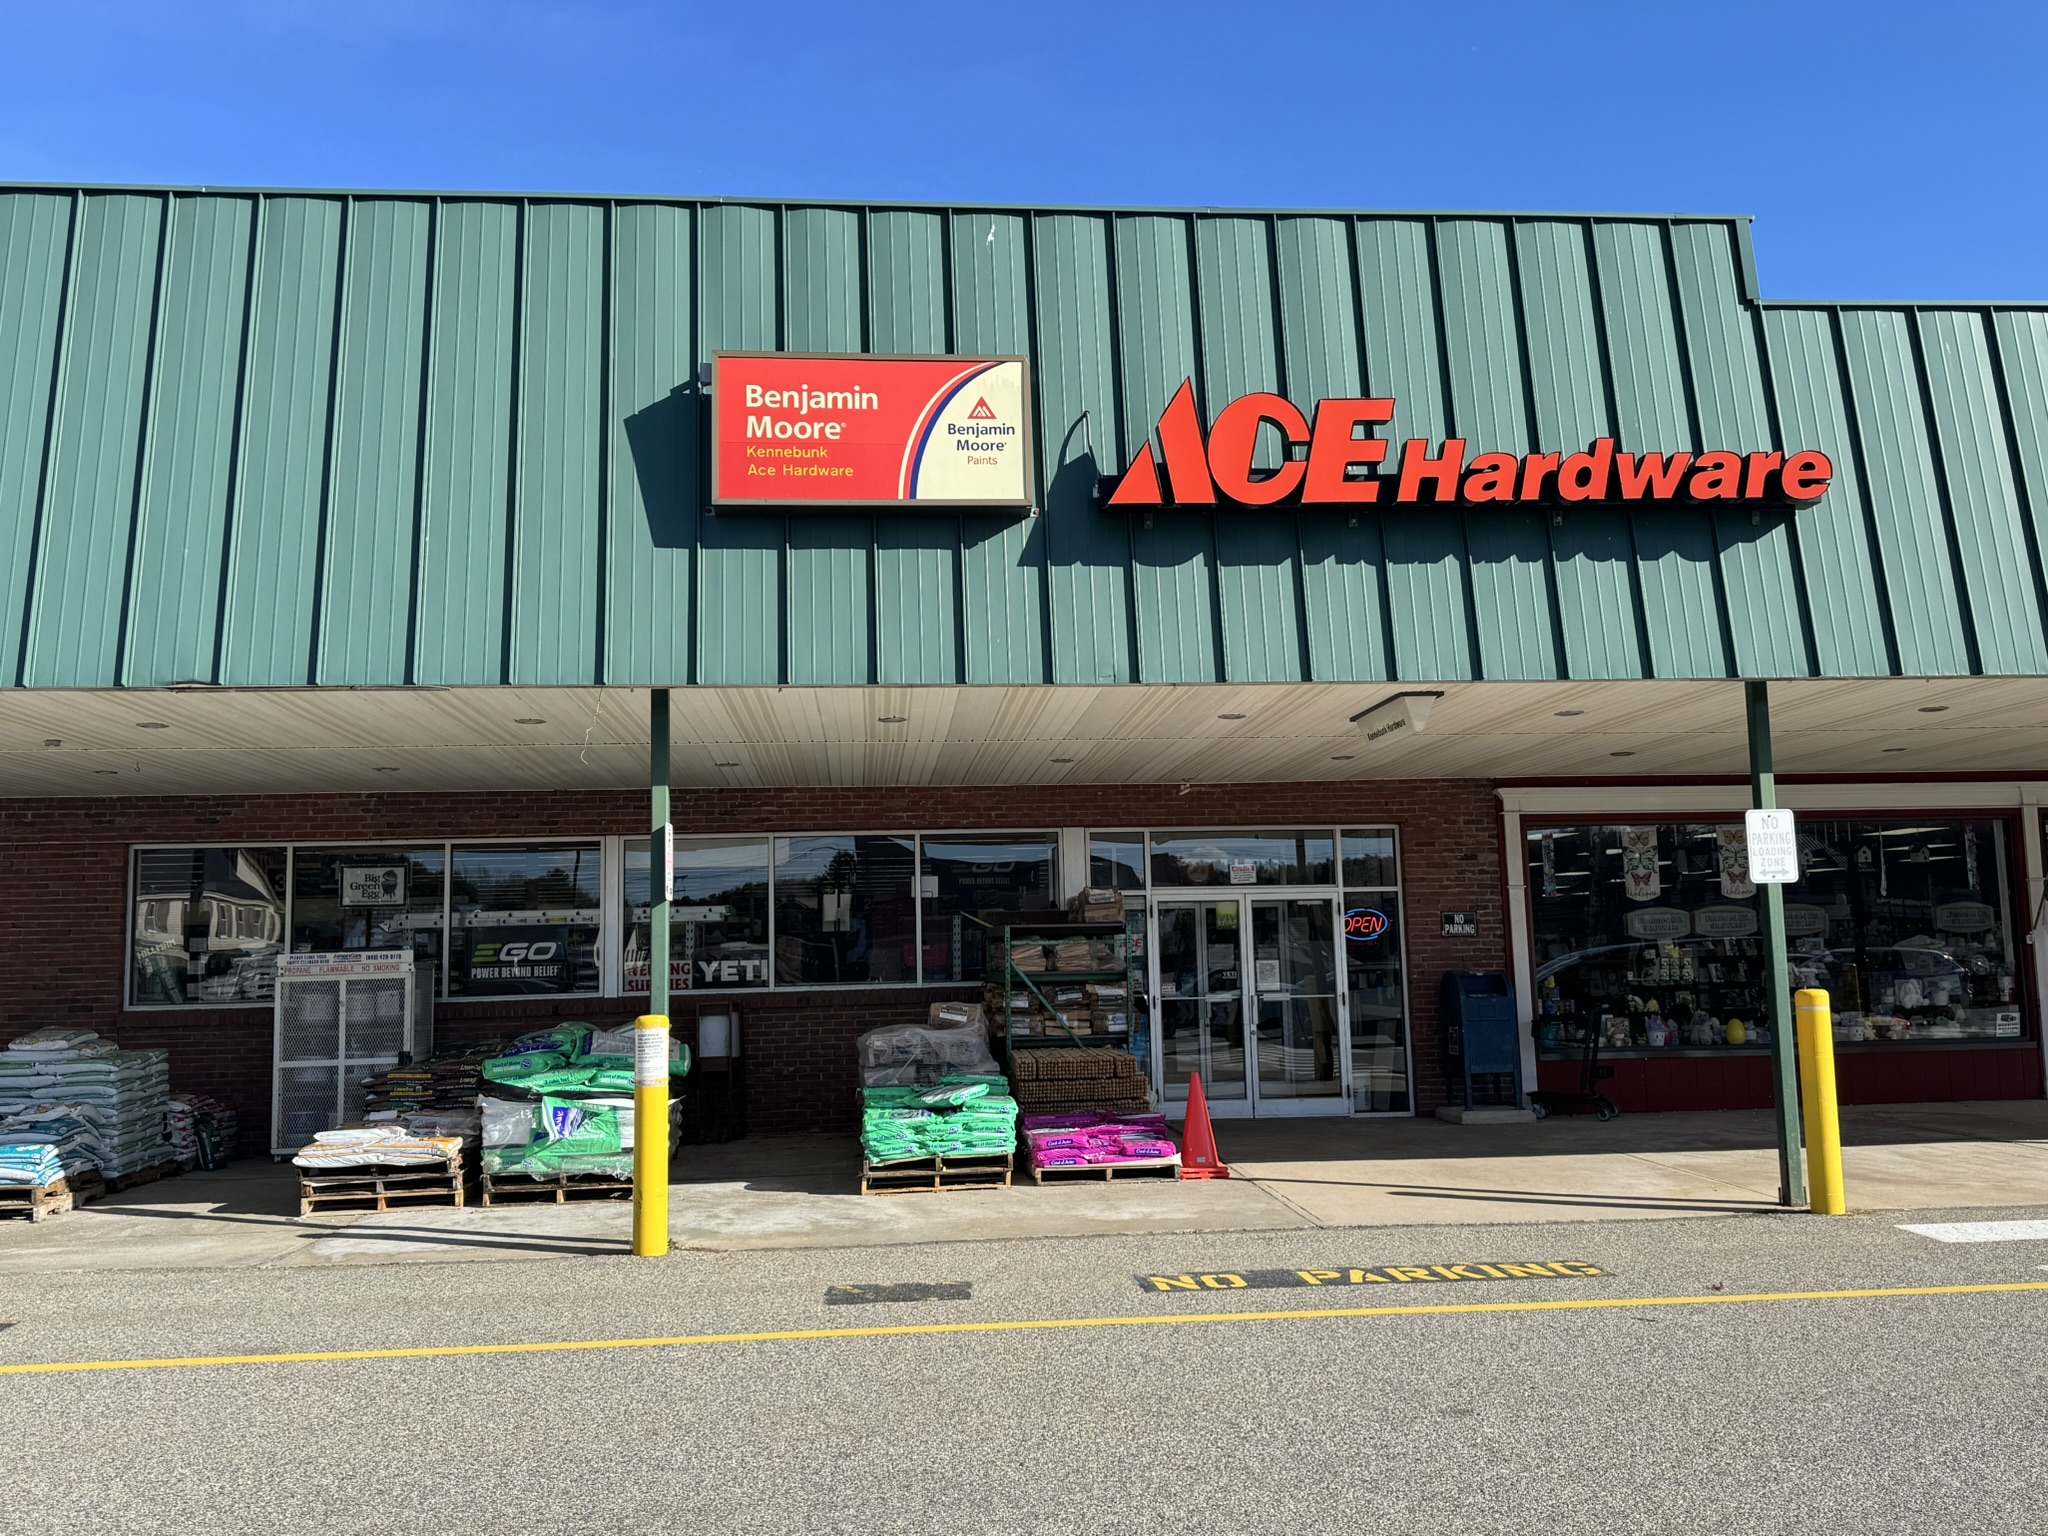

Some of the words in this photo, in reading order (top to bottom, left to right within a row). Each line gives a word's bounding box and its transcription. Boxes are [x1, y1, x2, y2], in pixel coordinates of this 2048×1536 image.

[745, 383, 879, 415] Benjamin
[947, 422, 1016, 439] Benjamin
[1109, 376, 1394, 505] ACE
[1397, 439, 1833, 503] Hardware
[746, 445, 828, 459] Kennebunk
[967, 455, 998, 465] Paints
[747, 463, 777, 477] Ace
[782, 464, 854, 477] Hardware
[1387, 718, 1406, 734] Hardware
[1761, 816, 1779, 830] NO
[1751, 831, 1791, 846] PARKING
[1752, 846, 1792, 857] LOADING
[1760, 857, 1786, 867] ZONE
[365, 873, 381, 883] Big
[350, 882, 382, 891] Green
[1626, 885, 1657, 897] Welcome
[1722, 884, 1754, 896] Welcome
[362, 890, 380, 900] Egg
[1344, 917, 1382, 933] OPEN
[1453, 914, 1464, 924] NO
[1444, 923, 1475, 935] PARKING
[471, 941, 558, 963] EGO
[284, 967, 311, 975] PROPANE
[319, 965, 354, 974] FLAMMABLE
[373, 963, 400, 972] SMOKING
[471, 967, 499, 979] POWER
[501, 966, 532, 979] BEYOND
[534, 965, 559, 977] BELIEF
[628, 962, 691, 977] WENG
[697, 960, 769, 983] YETI
[628, 978, 689, 991] SUPIES
[1149, 1272, 1248, 1291] NO
[1296, 1261, 1604, 1286] PARKING
